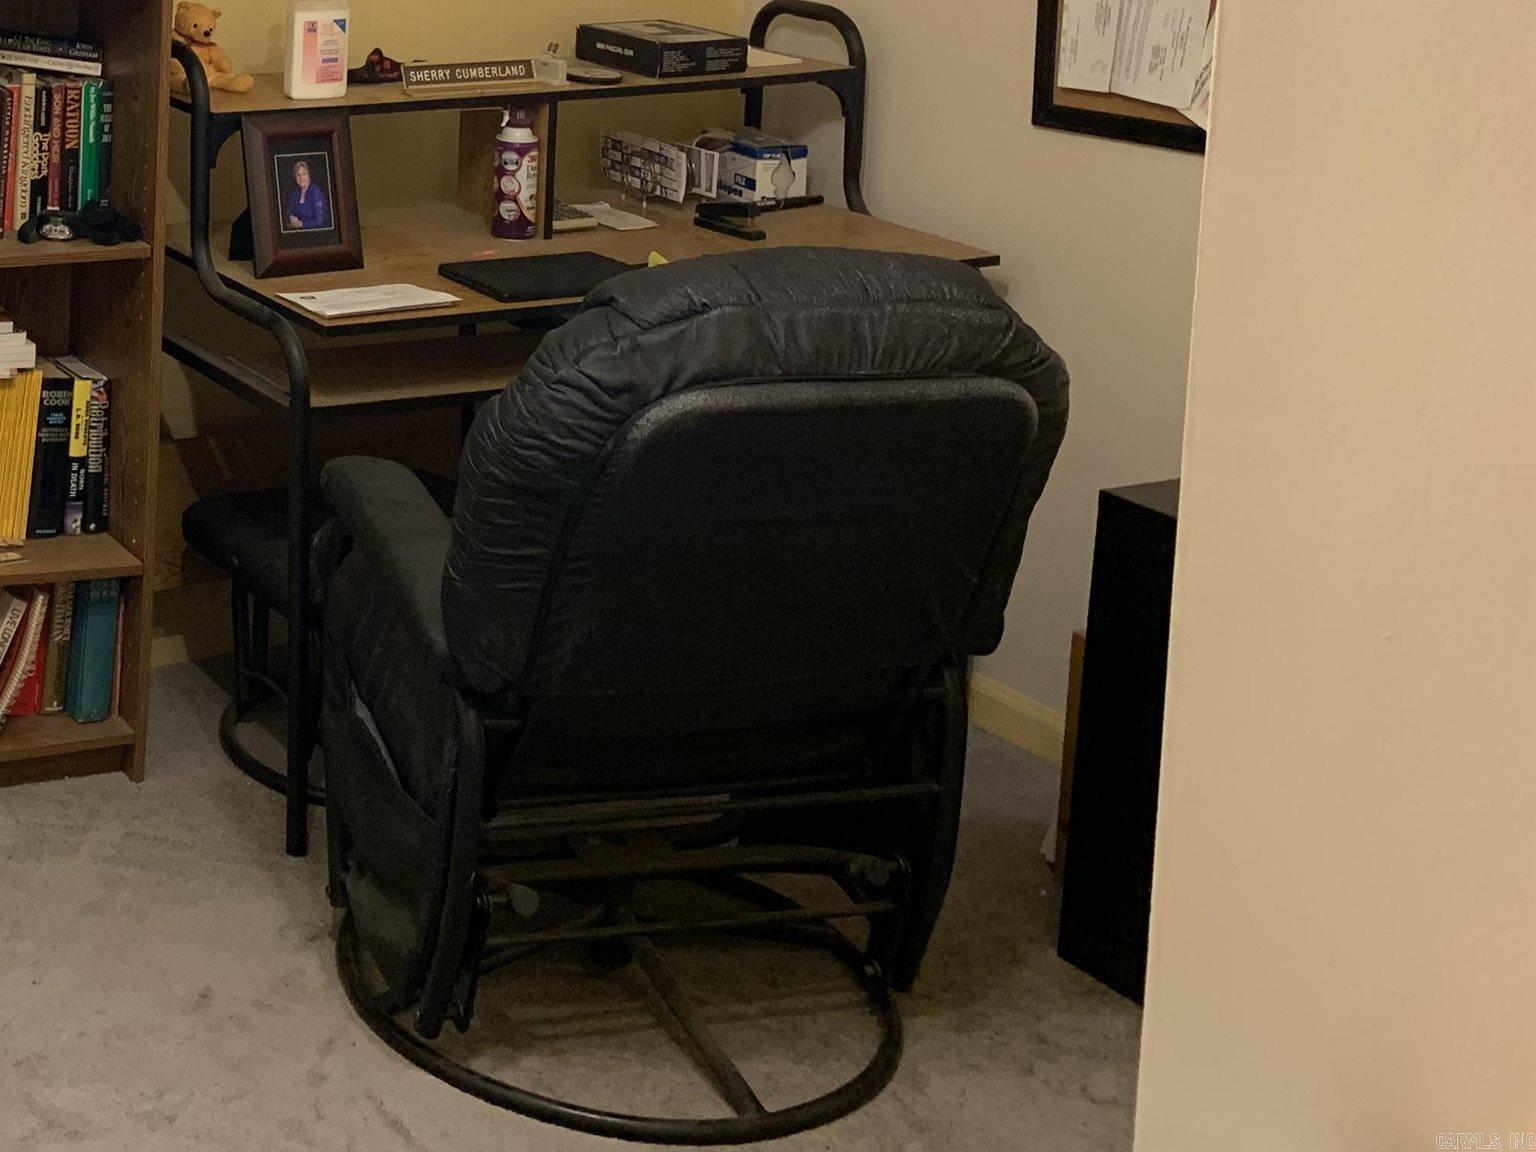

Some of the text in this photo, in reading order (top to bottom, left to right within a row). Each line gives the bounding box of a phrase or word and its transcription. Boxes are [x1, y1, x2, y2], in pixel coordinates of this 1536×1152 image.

[409, 65, 526, 82] SHERRY CUMBERLAND
[53, 92, 62, 114] SON
[52, 115, 62, 138] AND
[64, 89, 81, 150] RATOON
[41, 132, 52, 150] The
[31, 131, 44, 180] Goddess
[19, 158, 33, 209] Kingdom
[42, 390, 72, 400] ROBIN
[43, 400, 72, 409] COOK
[88, 400, 109, 473] Retribution
[69, 471, 78, 497] DEATH
[78, 468, 86, 491] BORN
[6, 607, 23, 627] LIVE
